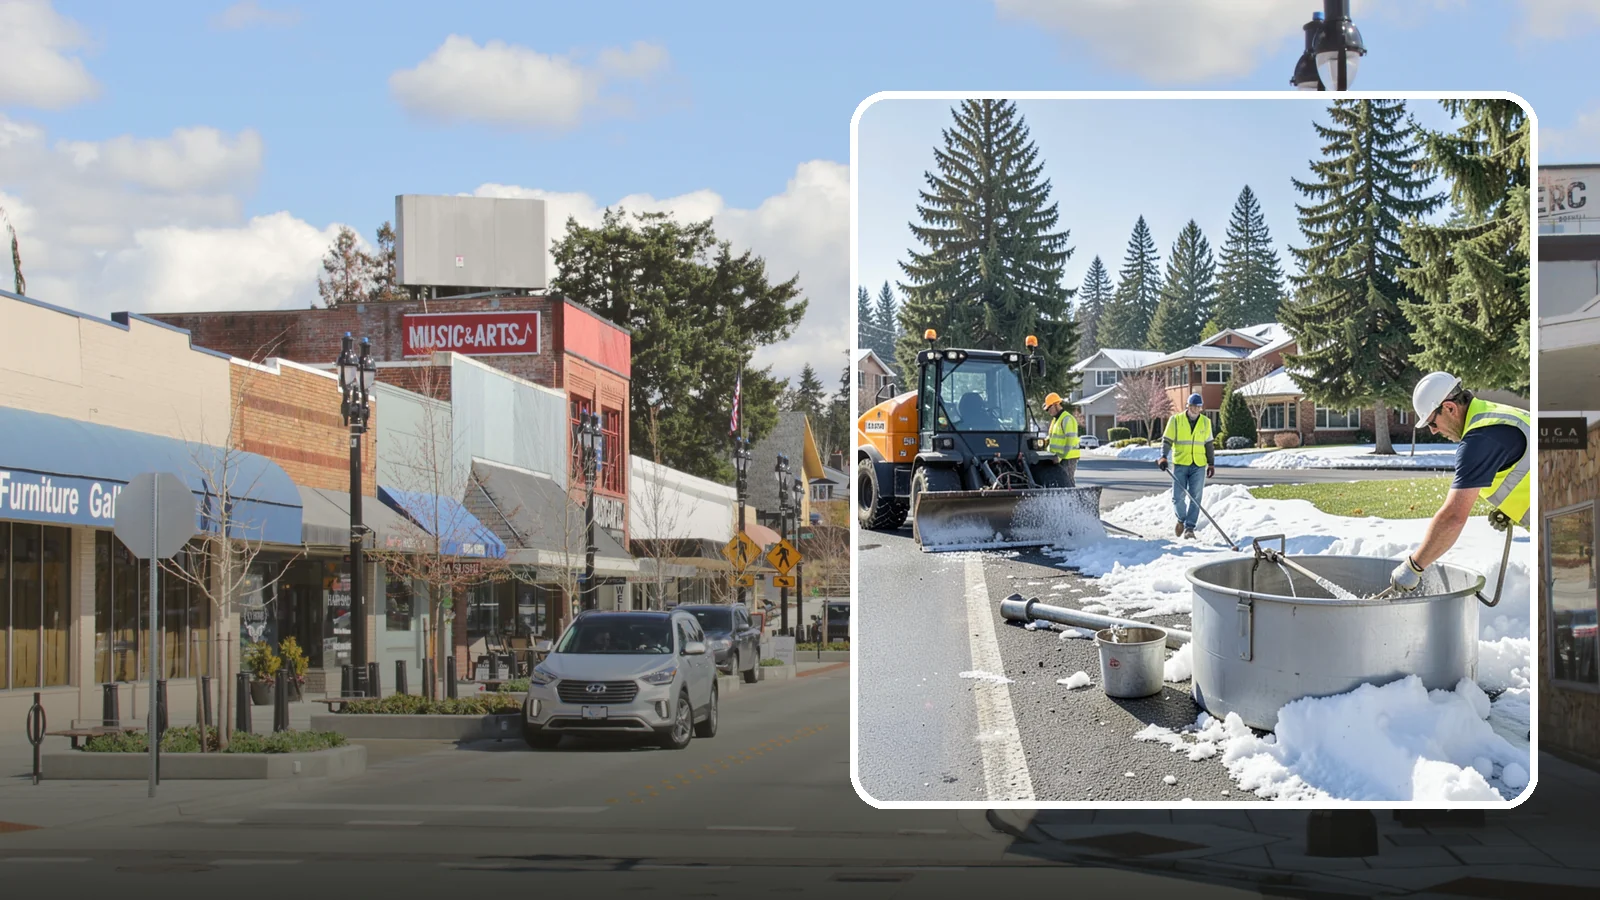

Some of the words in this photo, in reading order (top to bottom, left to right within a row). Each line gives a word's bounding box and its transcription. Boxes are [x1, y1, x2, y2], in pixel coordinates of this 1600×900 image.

[0, 471, 79, 515] Furniture
[89, 482, 121, 519] Gal
[453, 563, 480, 573] SUSHI
